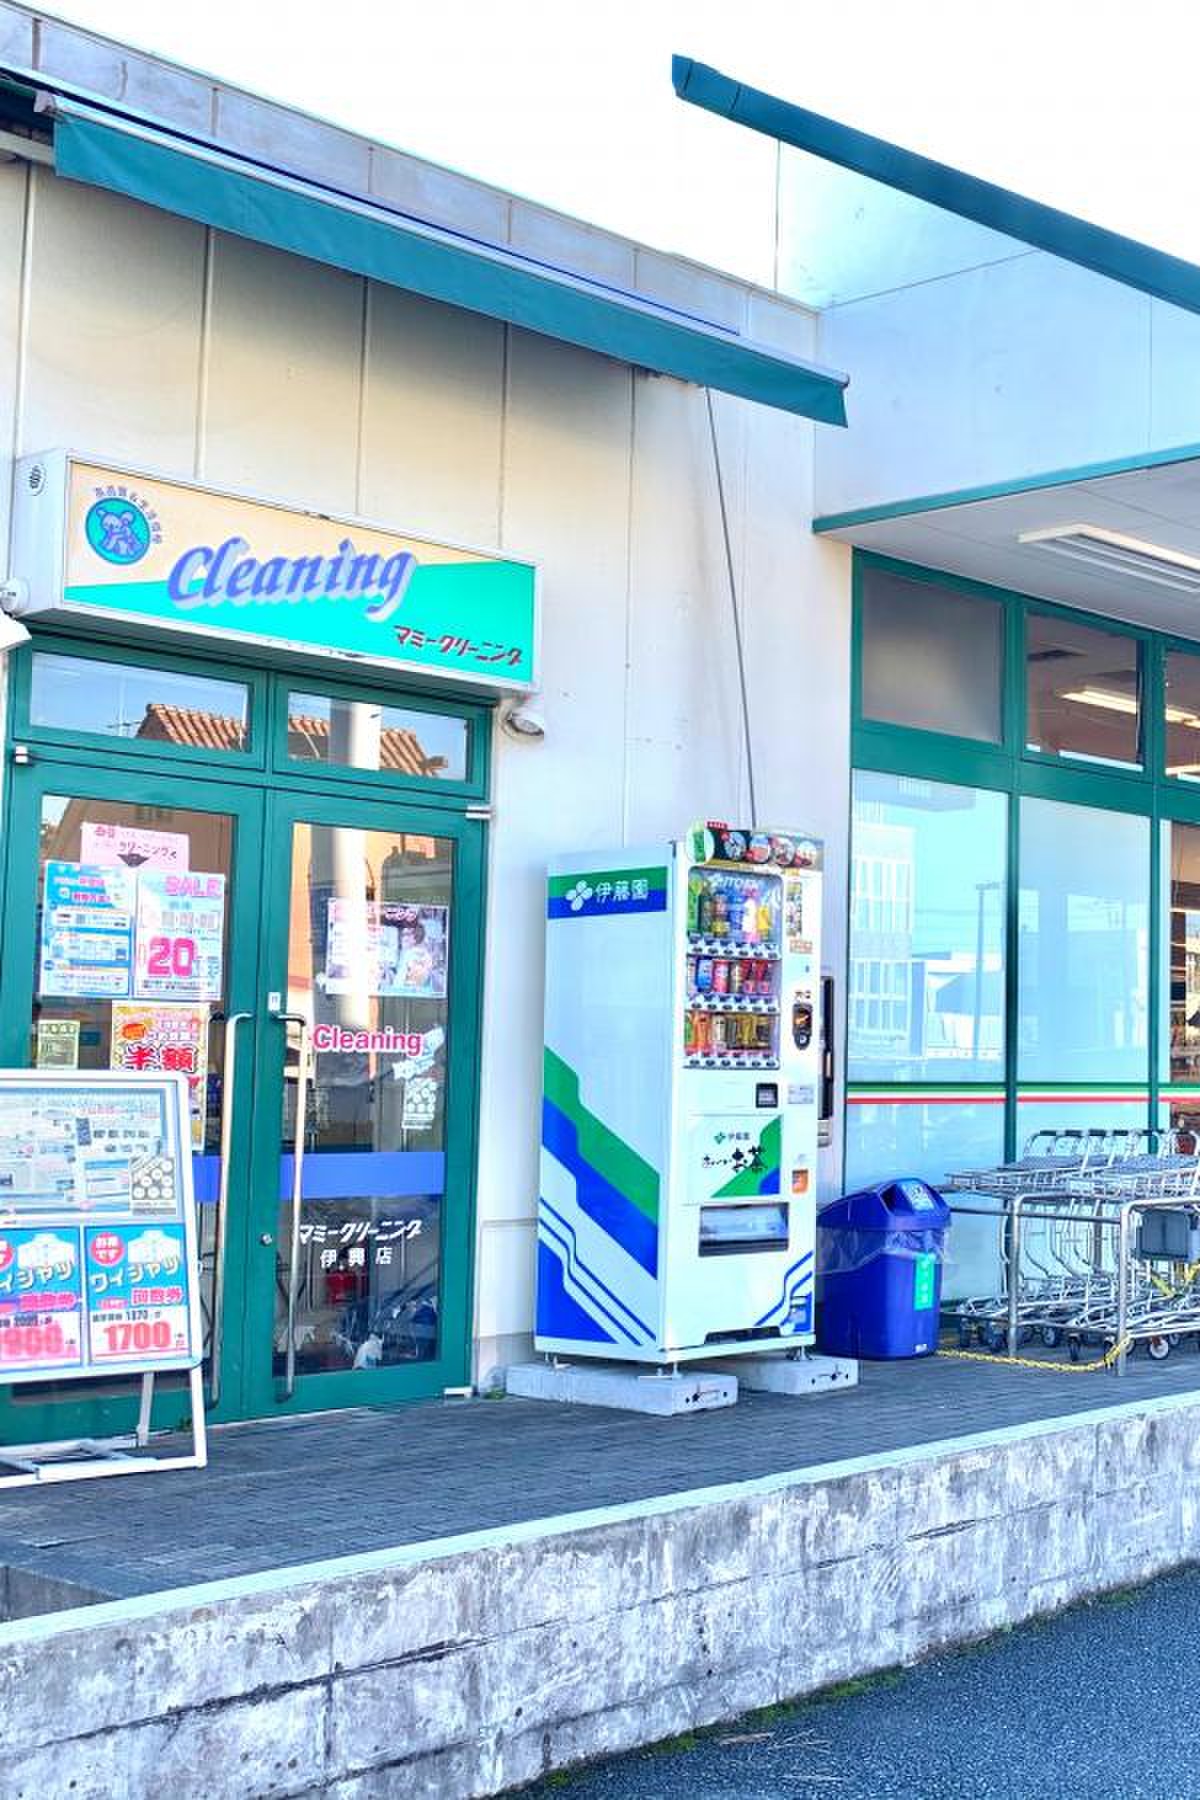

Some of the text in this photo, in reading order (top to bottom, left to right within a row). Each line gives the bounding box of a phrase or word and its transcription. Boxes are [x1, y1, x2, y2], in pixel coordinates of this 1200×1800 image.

[167, 536, 416, 621] Cleaning
[393, 625, 523, 667] マミークリーニング
[165, 875, 223, 897] SALE
[594, 878, 649, 905] 伊藤園
[147, 935, 195, 978] 20
[312, 1025, 424, 1057] Cleaning
[299, 1219, 422, 1245] マミークリーニング
[90, 1255, 179, 1292] ワイシャツ
[320, 1247, 393, 1269] 伊興店
[104, 1321, 171, 1351] 1700
